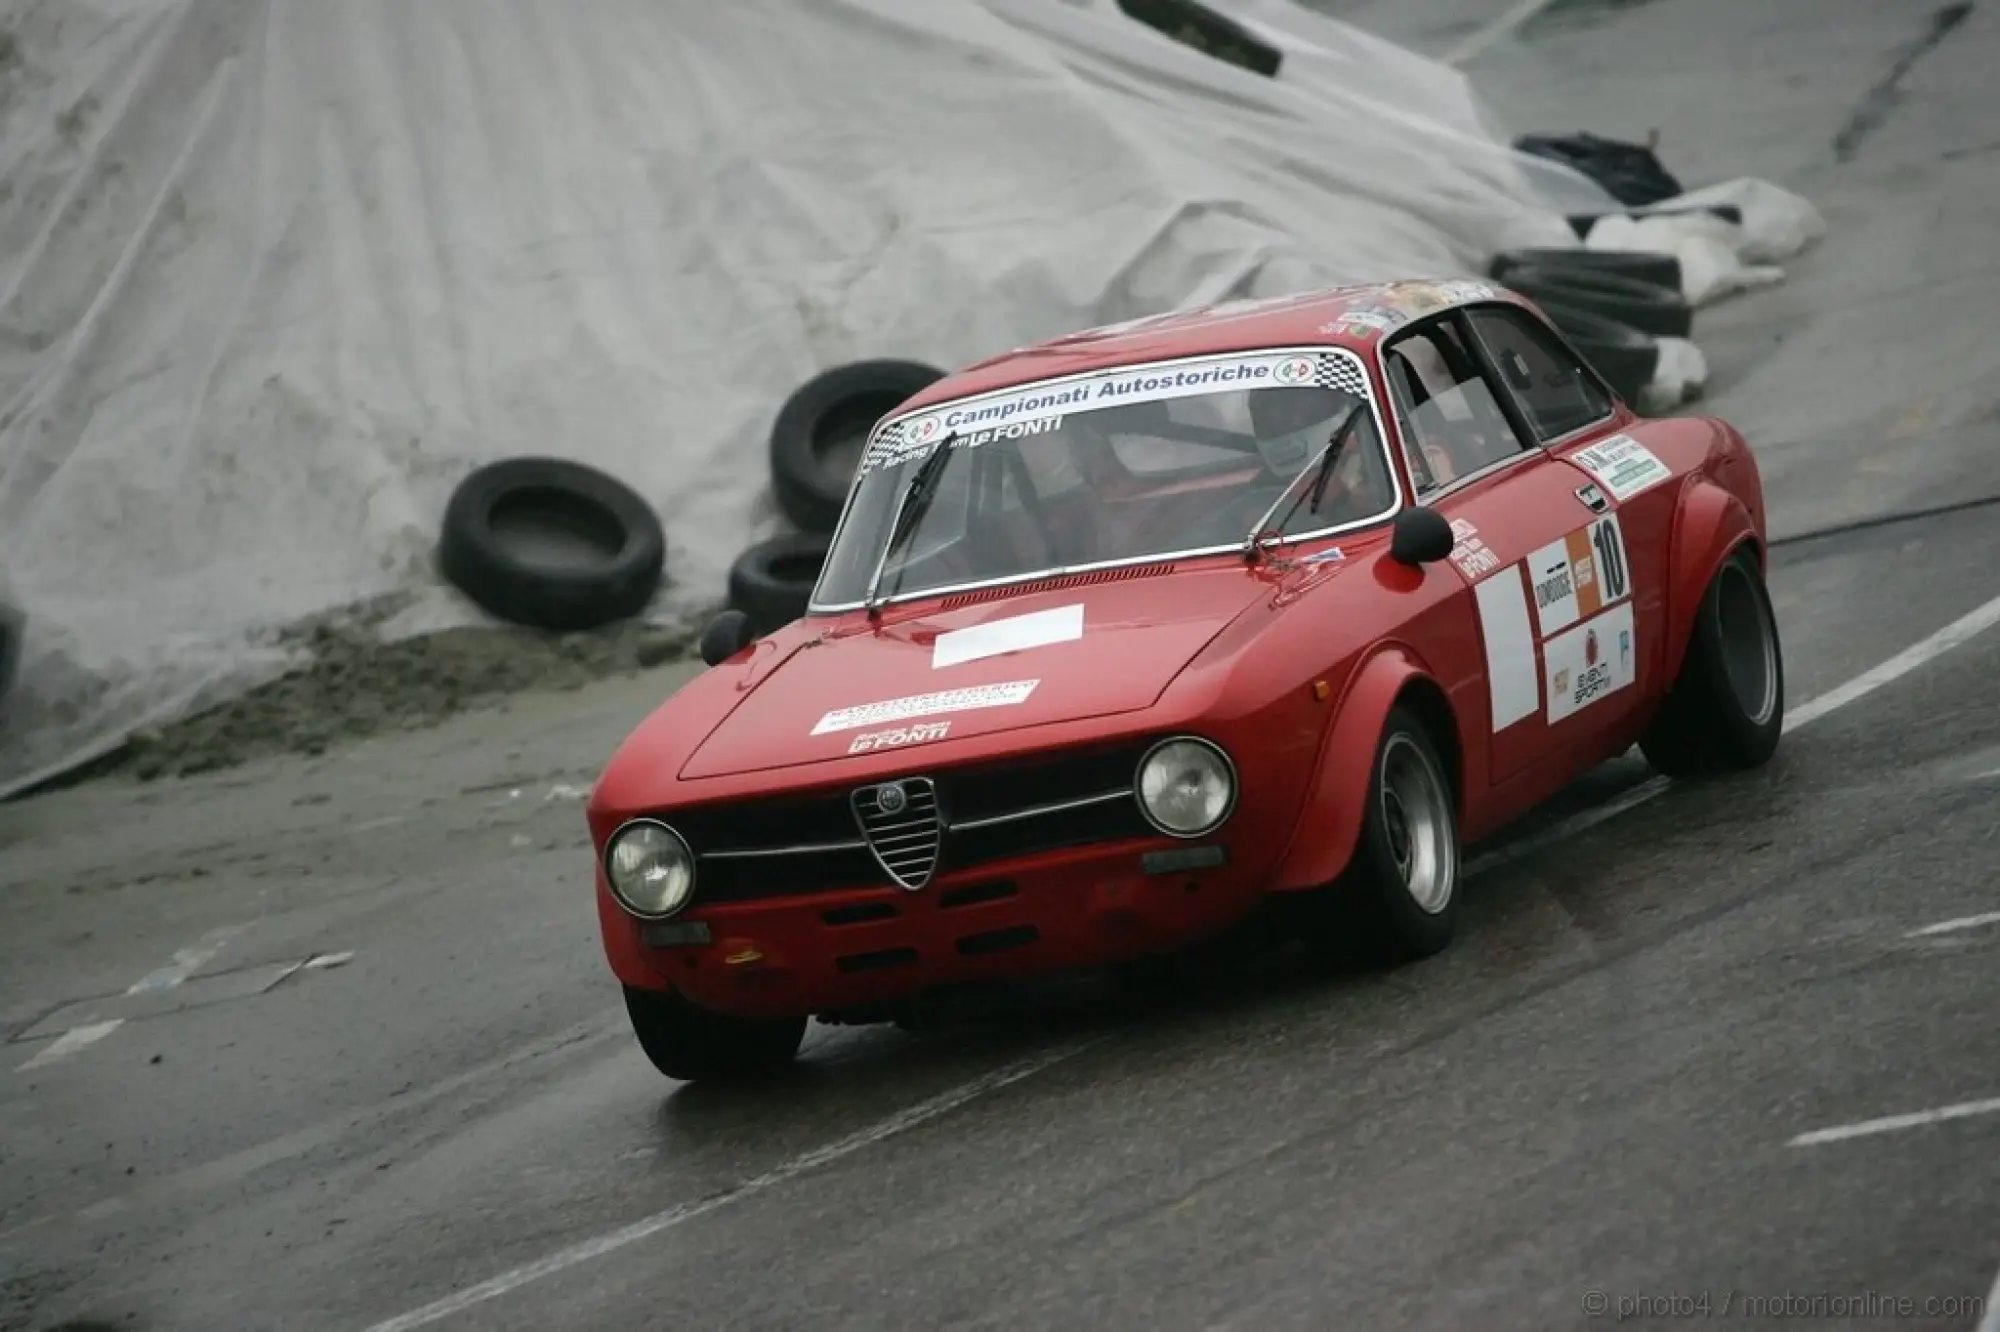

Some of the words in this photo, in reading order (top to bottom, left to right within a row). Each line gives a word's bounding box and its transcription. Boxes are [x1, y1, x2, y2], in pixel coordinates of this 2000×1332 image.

[945, 385, 1090, 427] Campionati
[1097, 364, 1270, 398] Autostoriche
[993, 414, 1064, 444] FONTI
[1594, 518, 1625, 599] 10
[873, 726, 949, 749] FONTI
